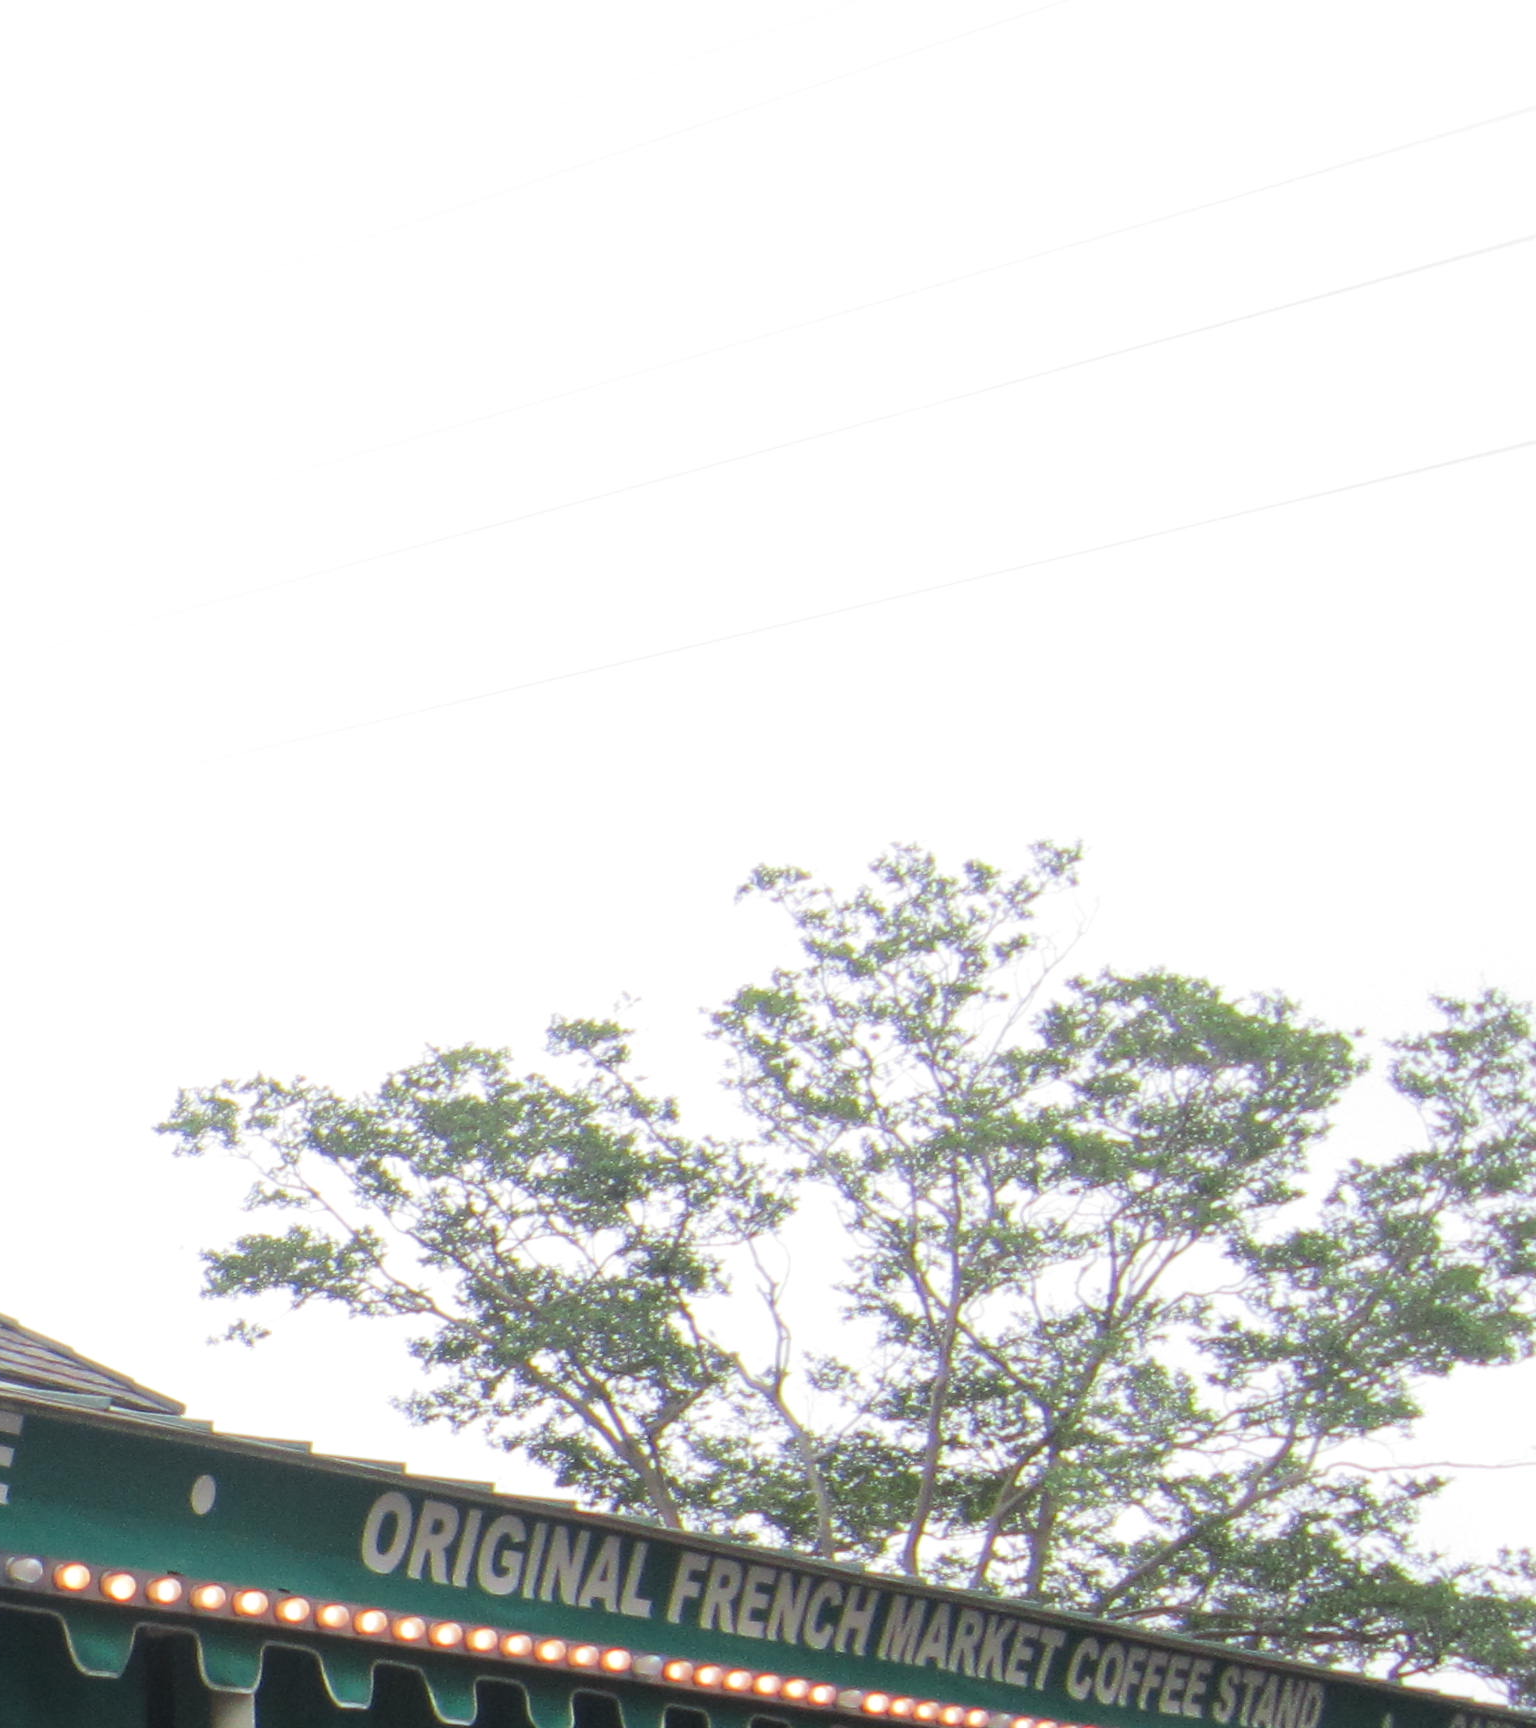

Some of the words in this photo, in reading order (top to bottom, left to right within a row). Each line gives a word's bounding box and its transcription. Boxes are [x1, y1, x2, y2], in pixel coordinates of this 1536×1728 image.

[361, 1491, 654, 1619] ORIGINAL
[666, 1551, 879, 1656] FRENCH
[877, 1591, 1066, 1692] MARKET
[1066, 1637, 1215, 1719] COFFEE
